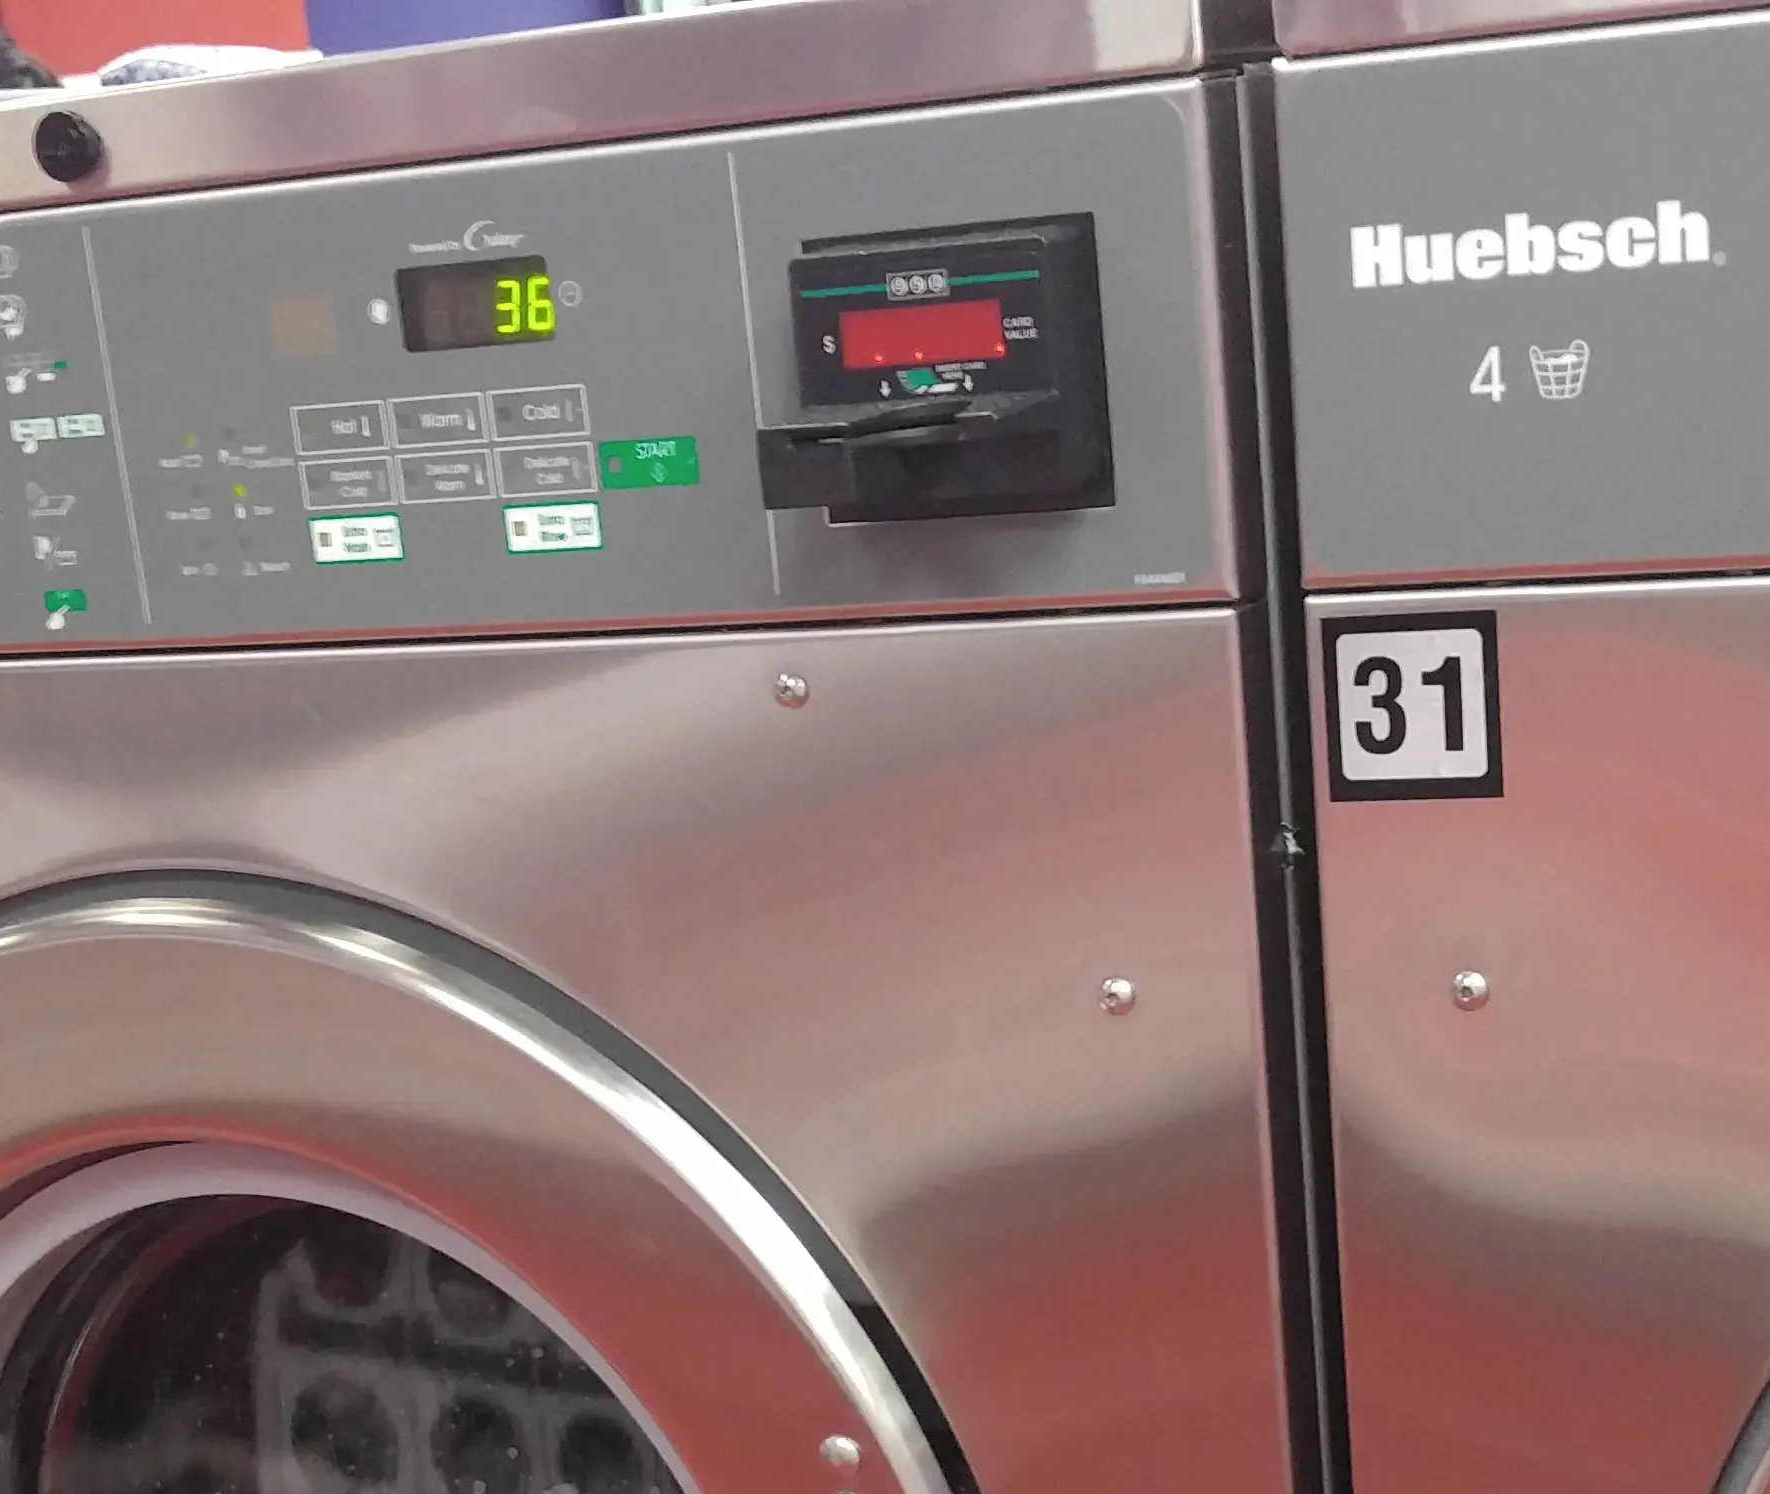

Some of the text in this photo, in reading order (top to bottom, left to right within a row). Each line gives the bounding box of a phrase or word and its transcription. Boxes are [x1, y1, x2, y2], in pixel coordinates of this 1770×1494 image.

[1350, 199, 1711, 288] Huebsch
[496, 274, 555, 334] 36
[1004, 328, 1038, 340] VALUE
[1469, 345, 1507, 402] 4
[419, 411, 463, 428] Warm
[522, 403, 560, 420] Cold
[634, 440, 676, 459] START
[1353, 655, 1465, 755] 31
